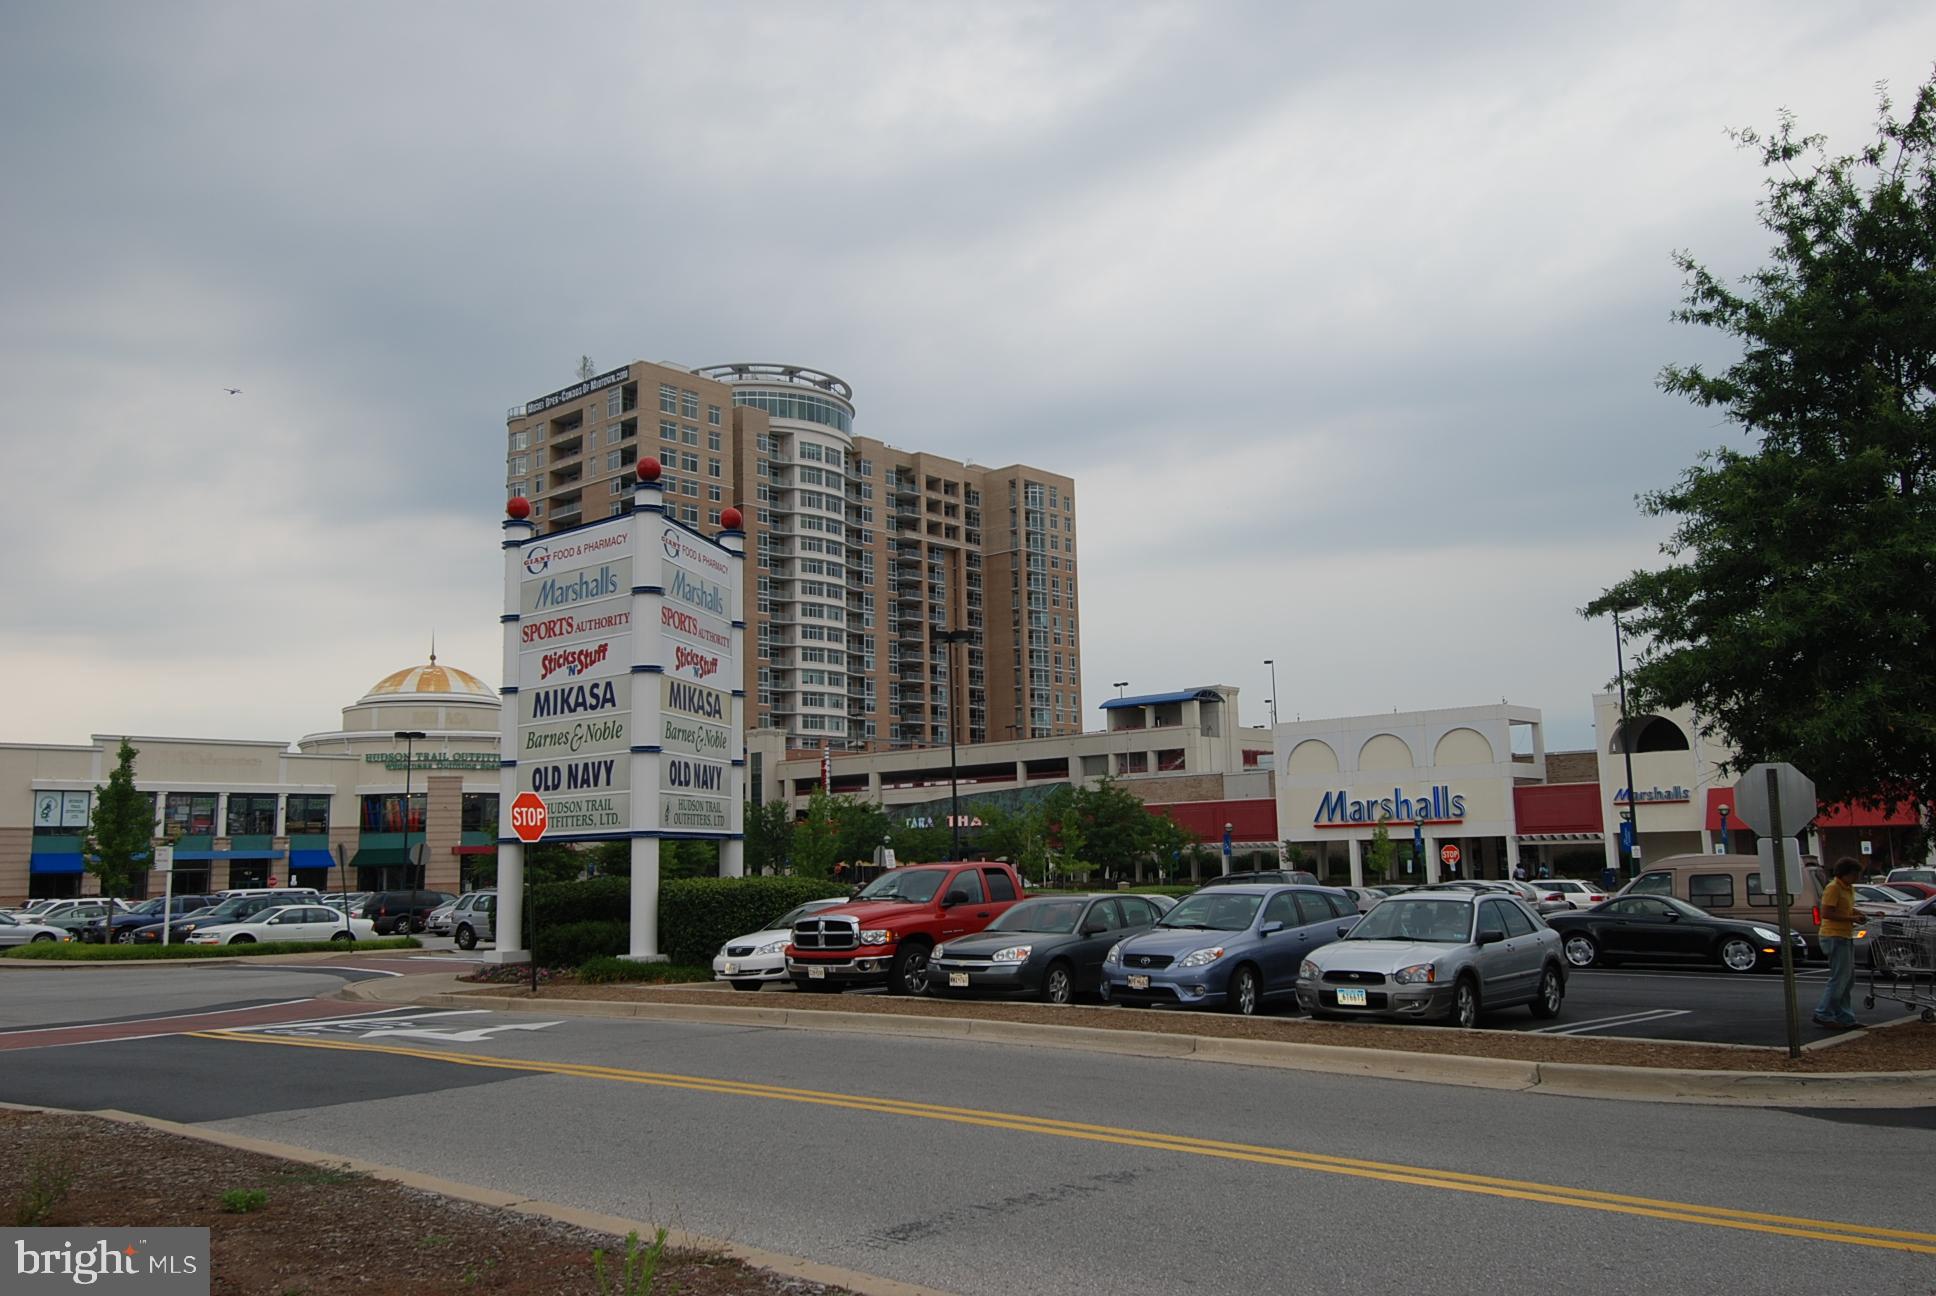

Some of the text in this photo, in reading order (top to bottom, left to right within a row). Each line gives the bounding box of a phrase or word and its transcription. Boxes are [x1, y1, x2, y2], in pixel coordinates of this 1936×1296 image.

[523, 533, 628, 566] GIANT FOOD & PHARMACY
[682, 545, 697, 560] FOOD
[698, 552, 702, 562] &
[702, 554, 729, 575] PHARMACY
[534, 565, 618, 610] Marshalls
[670, 570, 723, 615] Marshalls
[522, 612, 630, 643] SPORTS AUTHORITY
[661, 605, 730, 649] SPORTS AUTHORITY
[541, 649, 577, 680] Sticks
[576, 643, 609, 676] Stuff
[675, 645, 700, 672] Sticks
[699, 654, 718, 679] Stuff
[532, 681, 617, 718] MIKASA
[669, 681, 722, 720] MIKASA
[526, 720, 623, 752] Barnes & Noble
[665, 720, 727, 753] Barnes & Noble
[365, 753, 411, 763] HUDSON
[415, 752, 449, 761] TRAIL
[532, 759, 615, 793] OLD NAVY
[669, 759, 722, 791] OLD NAVY
[584, 798, 614, 813] TRAIL
[678, 798, 722, 814] HUDSON TRAIL
[1313, 784, 1467, 824] Marshalls
[1614, 785, 1690, 801] Marshalls
[513, 807, 545, 826] STOP
[599, 812, 621, 826] LTD.
[673, 812, 713, 826] OUTFITTERS,
[905, 815, 989, 829] TARA THA
[1442, 850, 1458, 859] STOP
